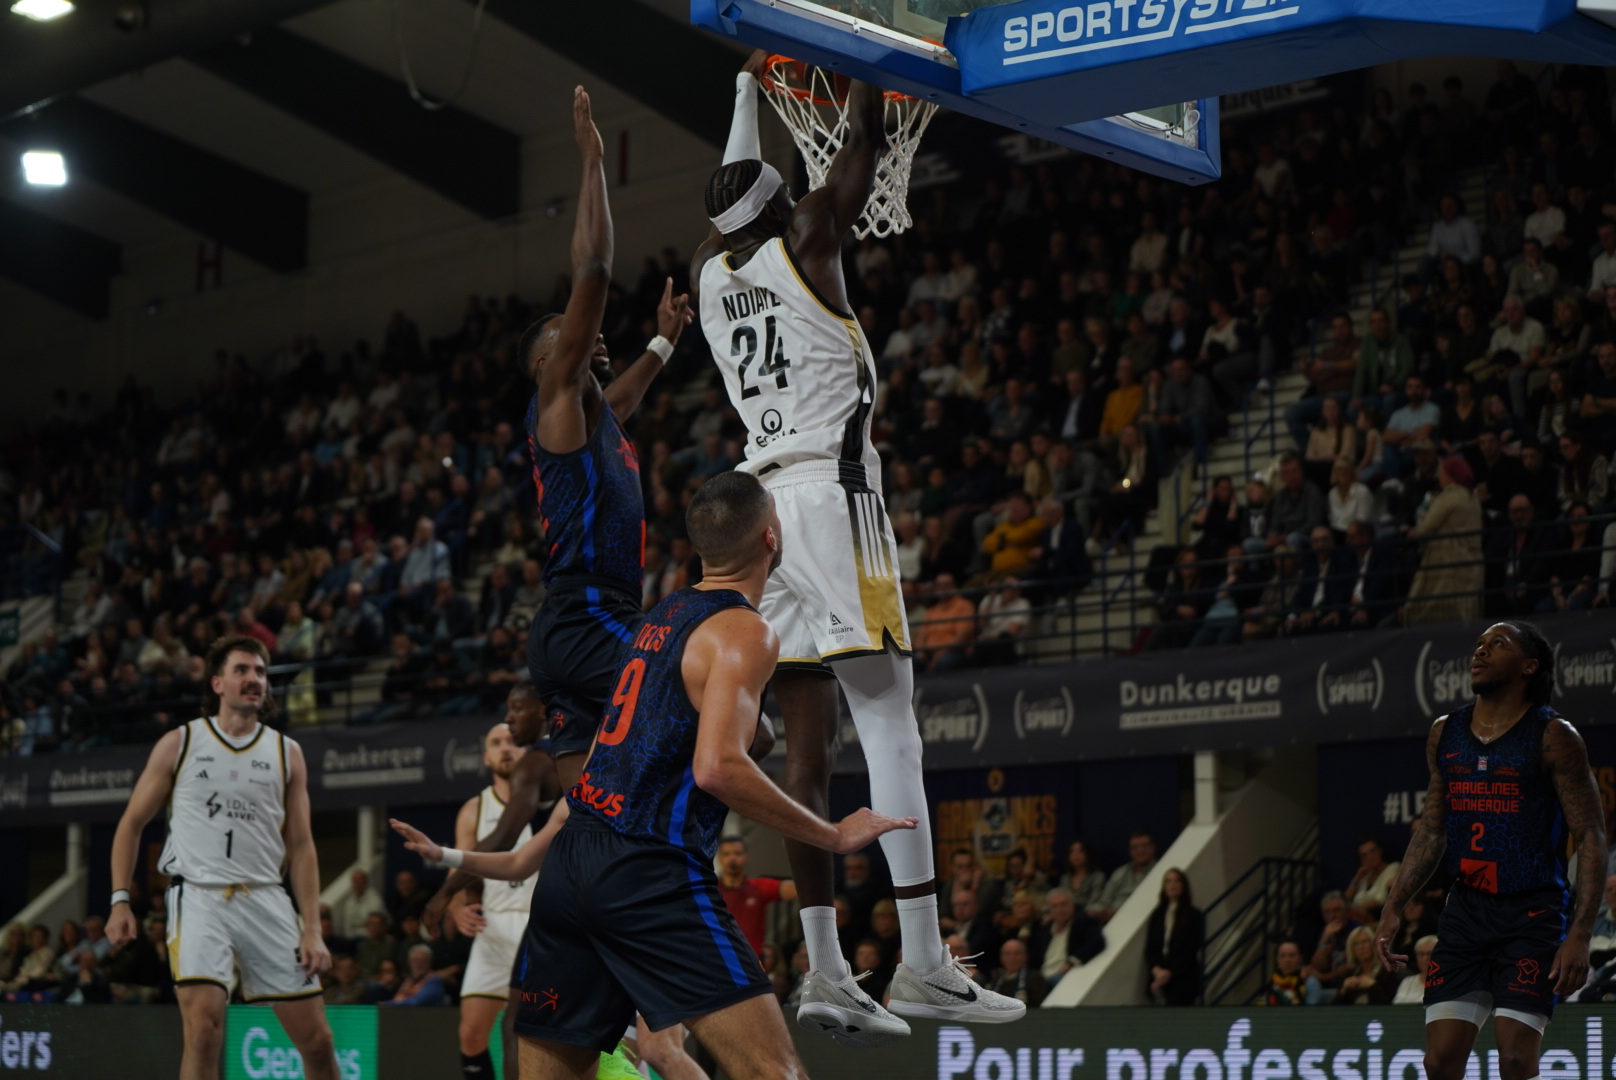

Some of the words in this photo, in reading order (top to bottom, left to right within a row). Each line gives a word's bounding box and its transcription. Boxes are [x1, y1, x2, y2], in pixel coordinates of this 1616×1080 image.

[1004, 0, 1288, 52] SPORTSYS
[730, 315, 791, 401] 24
[1120, 673, 1282, 707] Dunkerque
[1433, 670, 1473, 702] SPO
[1563, 662, 1615, 688] SPORT
[597, 658, 647, 746] 9
[1328, 681, 1375, 706] SPORT
[321, 744, 426, 771] Dunkerque
[50, 766, 135, 790] Dunkerque
[224, 830, 233, 859] 1
[1470, 822, 1485, 852] 2
[0, 1030, 52, 1070] ers
[937, 1026, 1084, 1080] Pour
